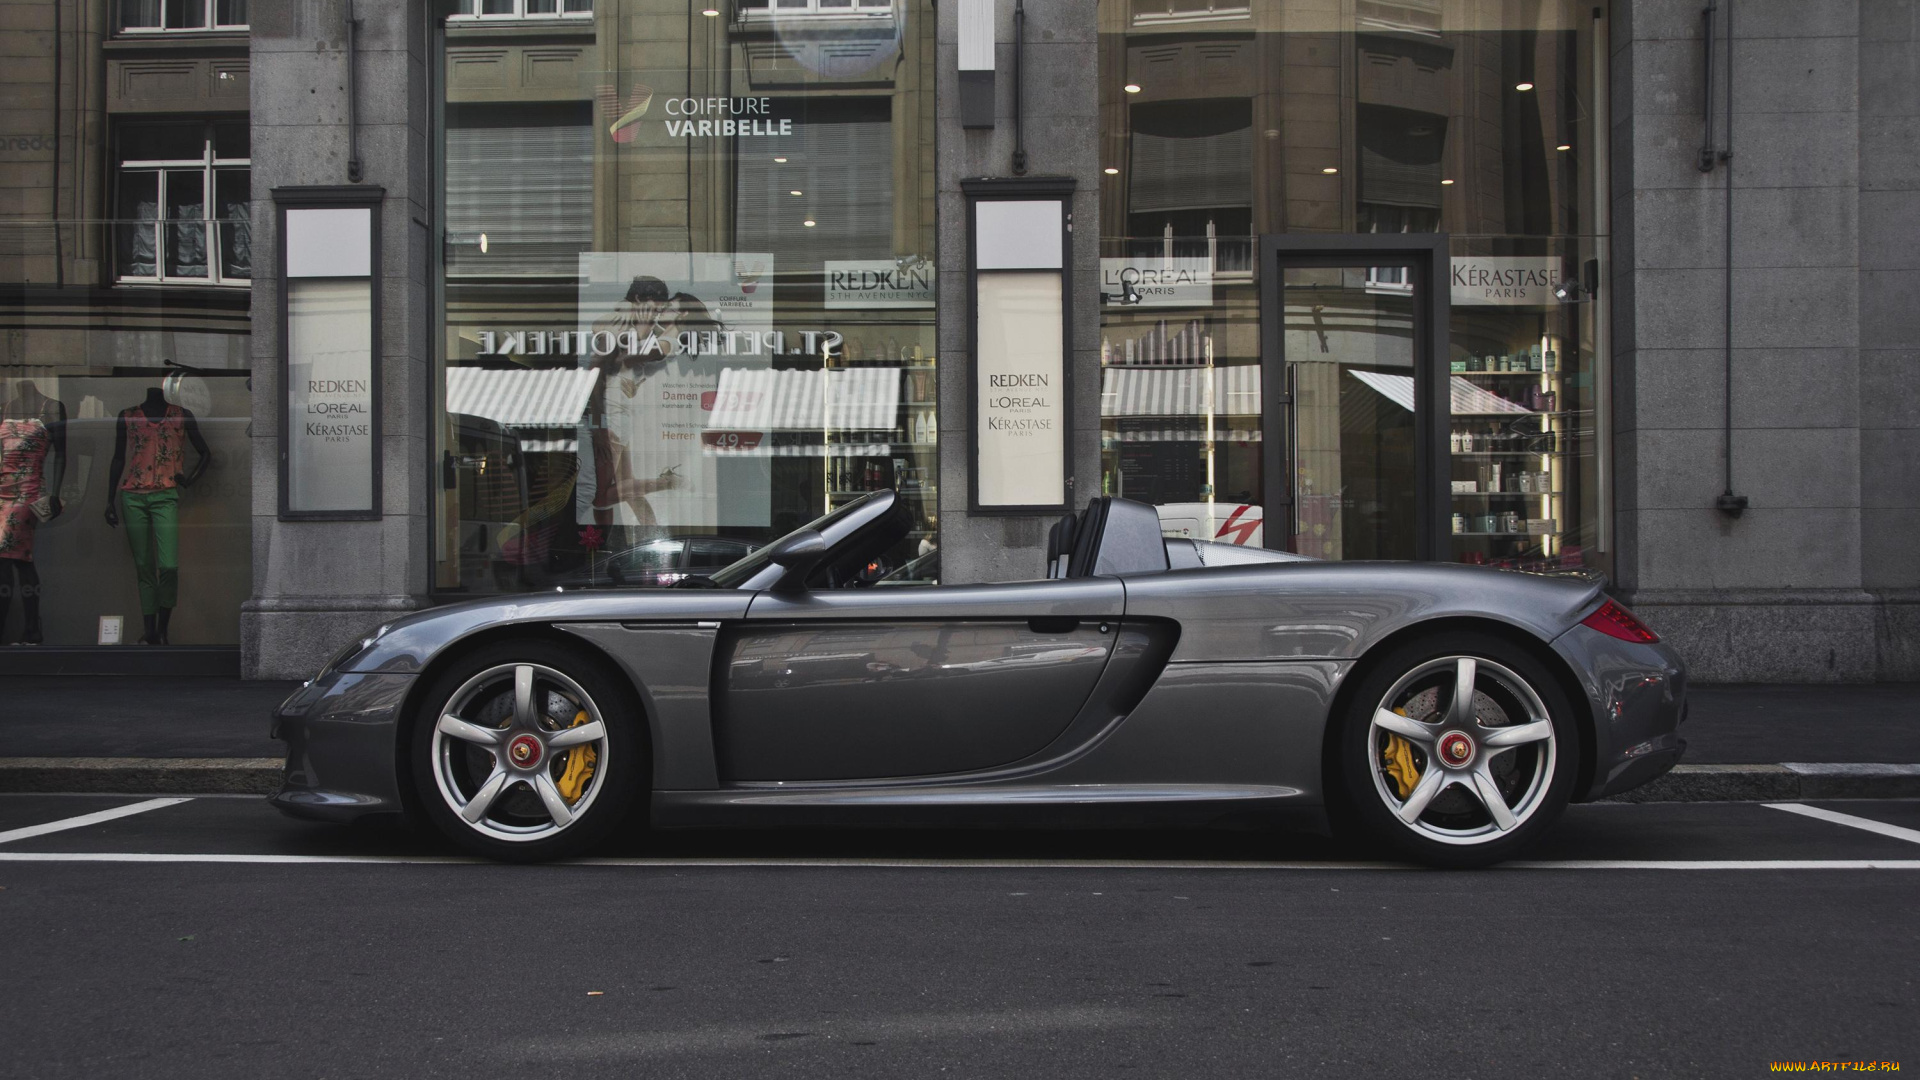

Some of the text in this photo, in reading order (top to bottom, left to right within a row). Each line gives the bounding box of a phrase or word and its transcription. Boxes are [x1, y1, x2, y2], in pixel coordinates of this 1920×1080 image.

[665, 98, 770, 115] COIFFURE
[665, 119, 792, 136] VARIBELLE
[830, 269, 929, 291] REDKEN
[1453, 264, 1558, 287] KÉRASTASE
[830, 291, 929, 300] 5TH AVENUE NYC
[1485, 288, 1526, 298] PARIS
[309, 380, 366, 393] REDKEN
[990, 374, 1048, 387] REDKEN
[662, 391, 698, 401] Damen
[307, 422, 368, 436] KÉRASTASE
[989, 417, 1052, 430] KÉRASTASE
[662, 431, 695, 440] Herren
